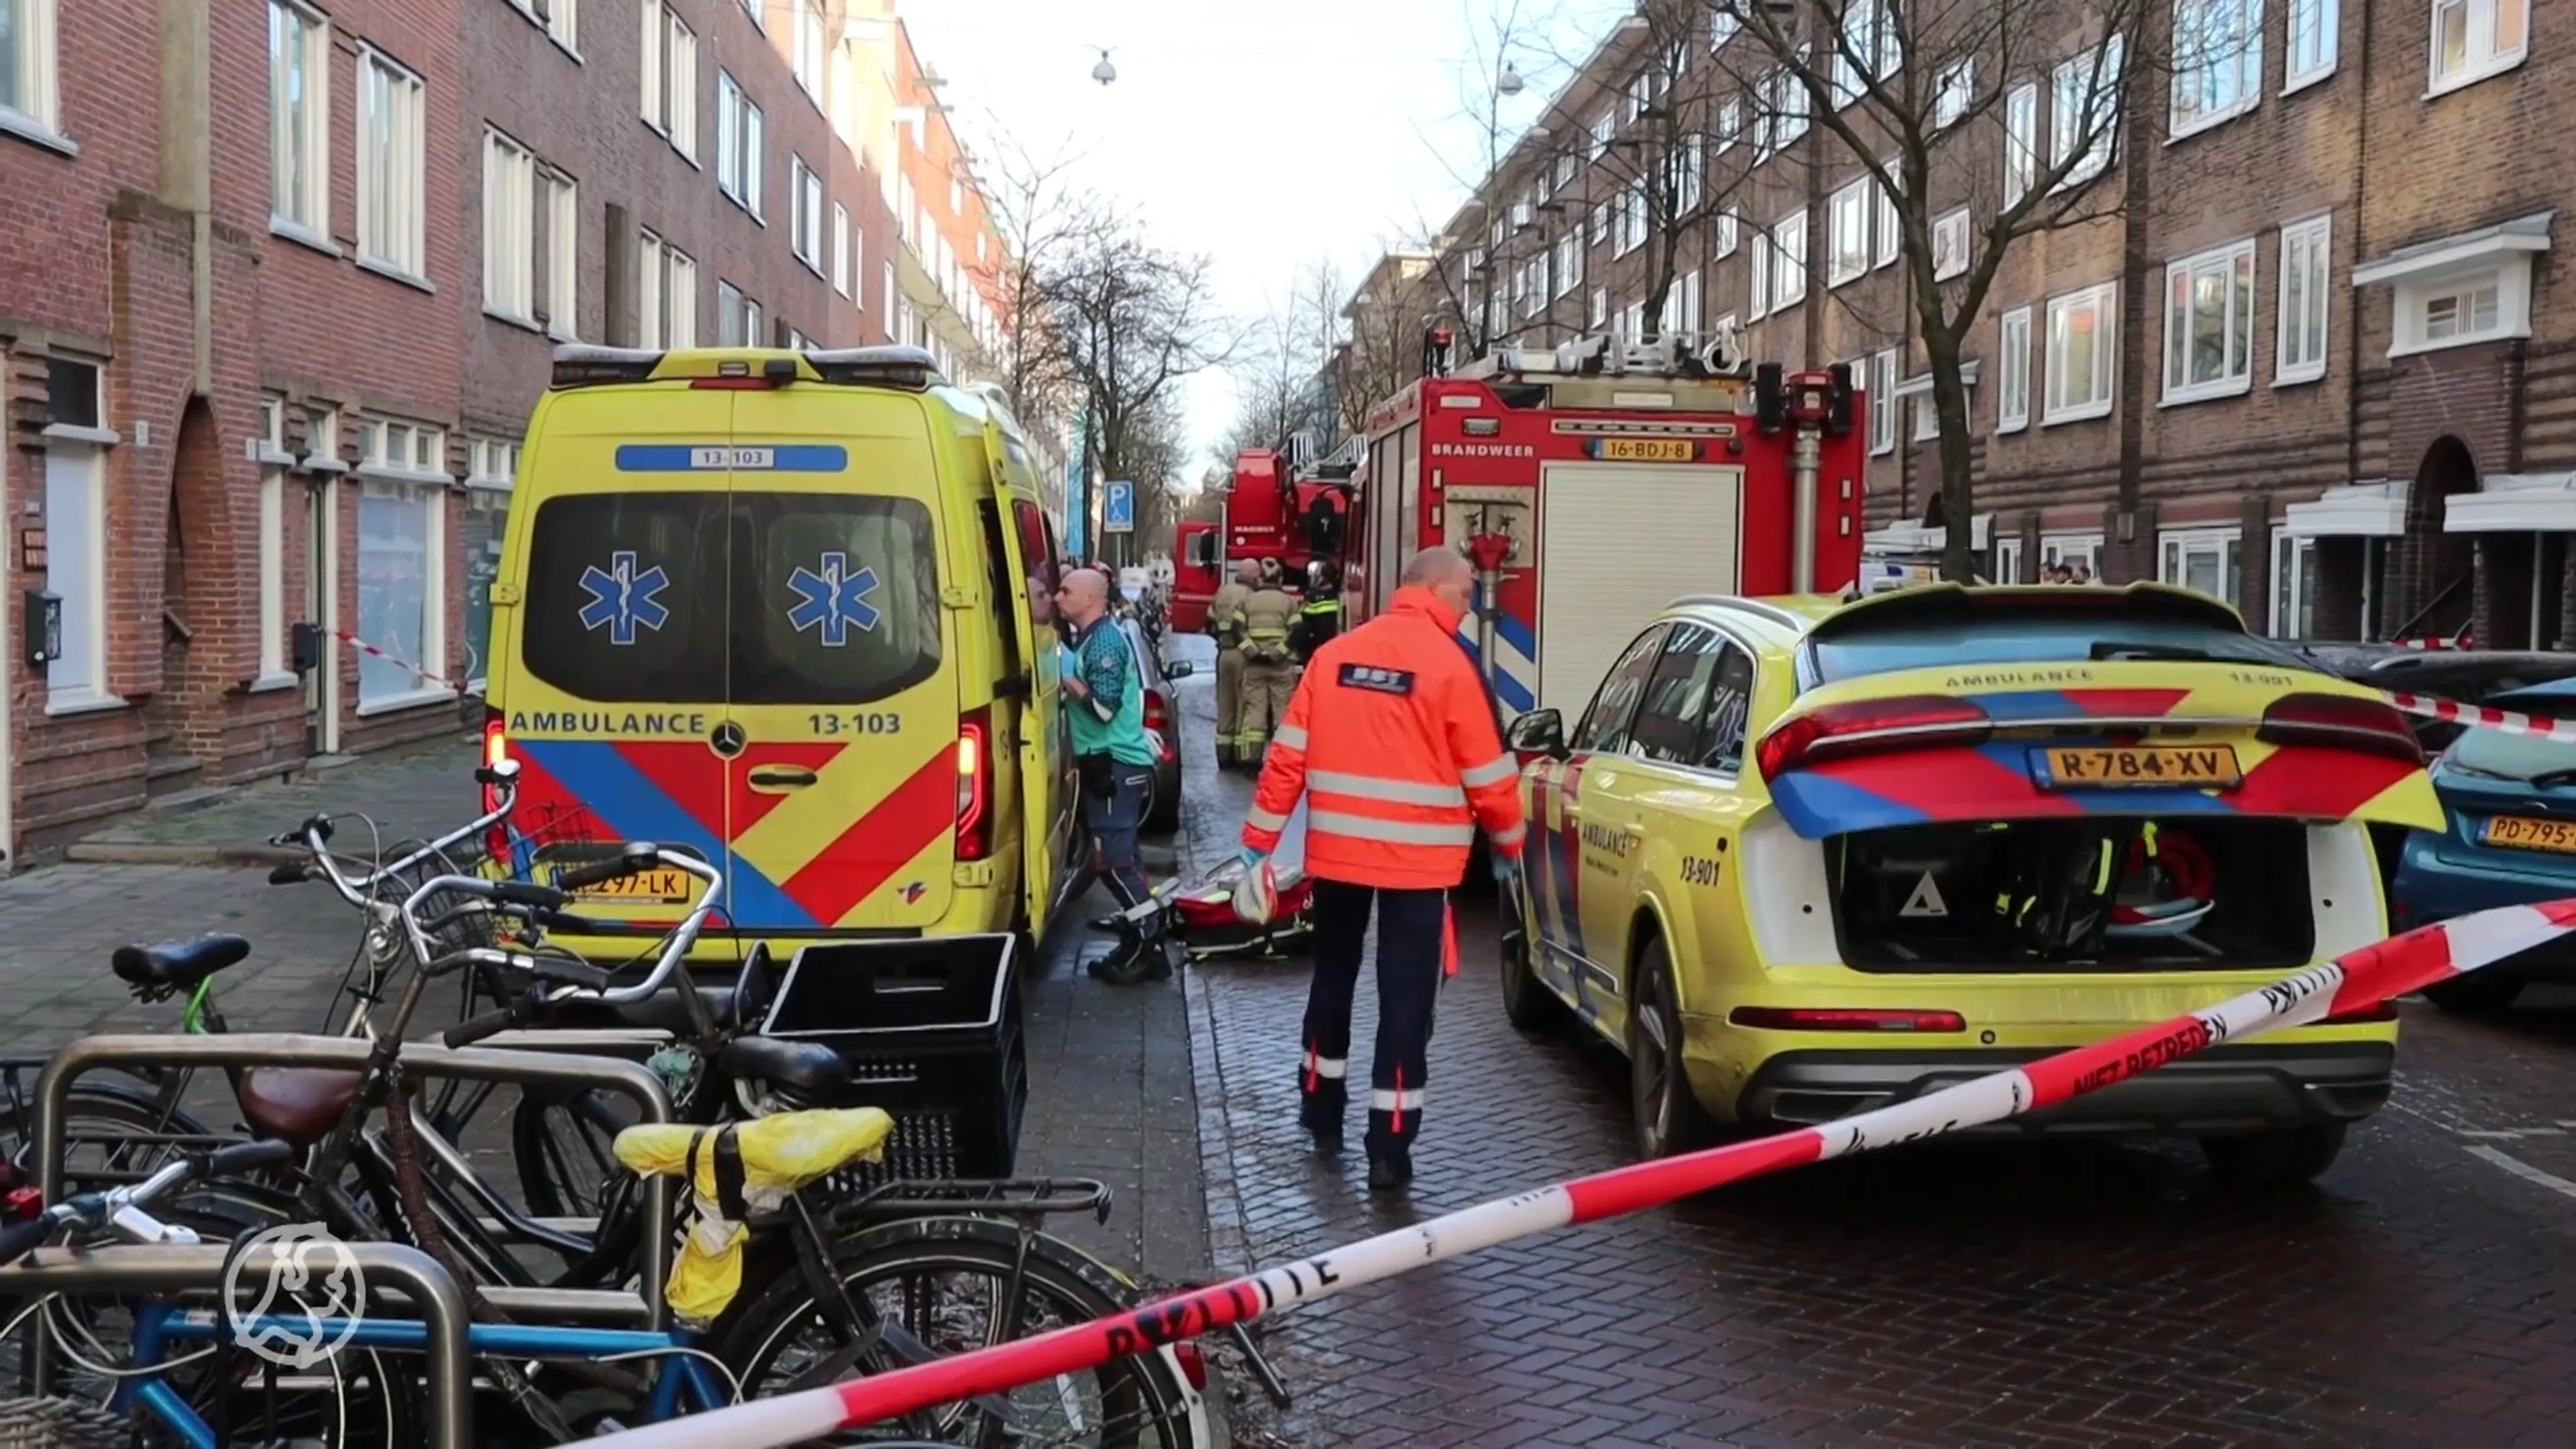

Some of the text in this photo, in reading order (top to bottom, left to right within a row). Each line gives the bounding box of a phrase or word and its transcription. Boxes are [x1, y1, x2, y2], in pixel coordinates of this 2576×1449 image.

[703, 451, 763, 464] 13-103
[1432, 443, 1535, 458] BRANDWEER
[1610, 441, 1685, 458] 16-BDJ-8
[1111, 486, 1126, 506] P
[1945, 669, 2094, 688] AMBULANCE
[510, 711, 901, 735] AMBULANCE 13-103
[2061, 751, 2220, 779] R-784-XV
[1582, 822, 1628, 859] AMBULANCE
[2493, 818, 2576, 845] PD-795-
[1680, 855, 1721, 888] 13-901
[2125, 1012, 2228, 1075] BETREDEN
